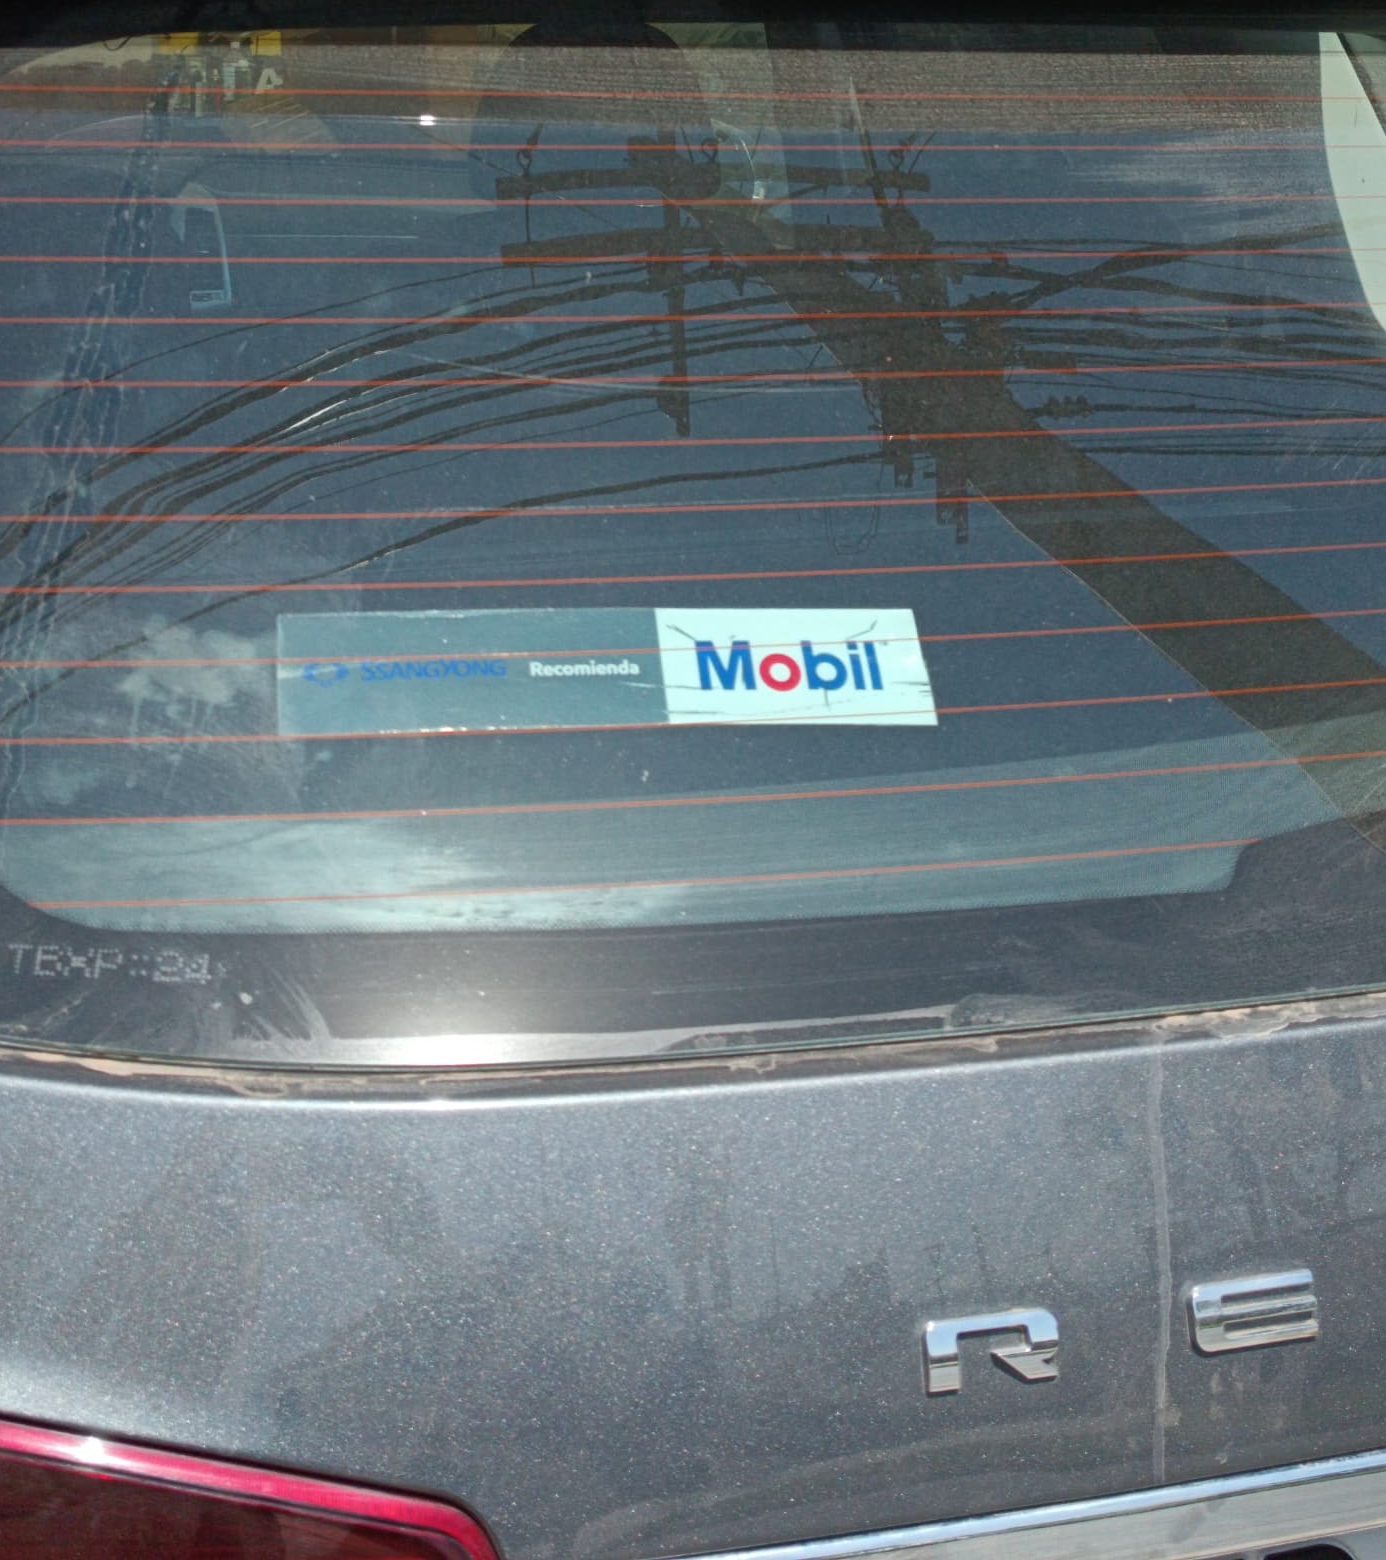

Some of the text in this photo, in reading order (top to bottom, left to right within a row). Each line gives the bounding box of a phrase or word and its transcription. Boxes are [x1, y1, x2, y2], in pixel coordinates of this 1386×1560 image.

[361, 641, 883, 690] SSANGYONG Recomienda Mobil
